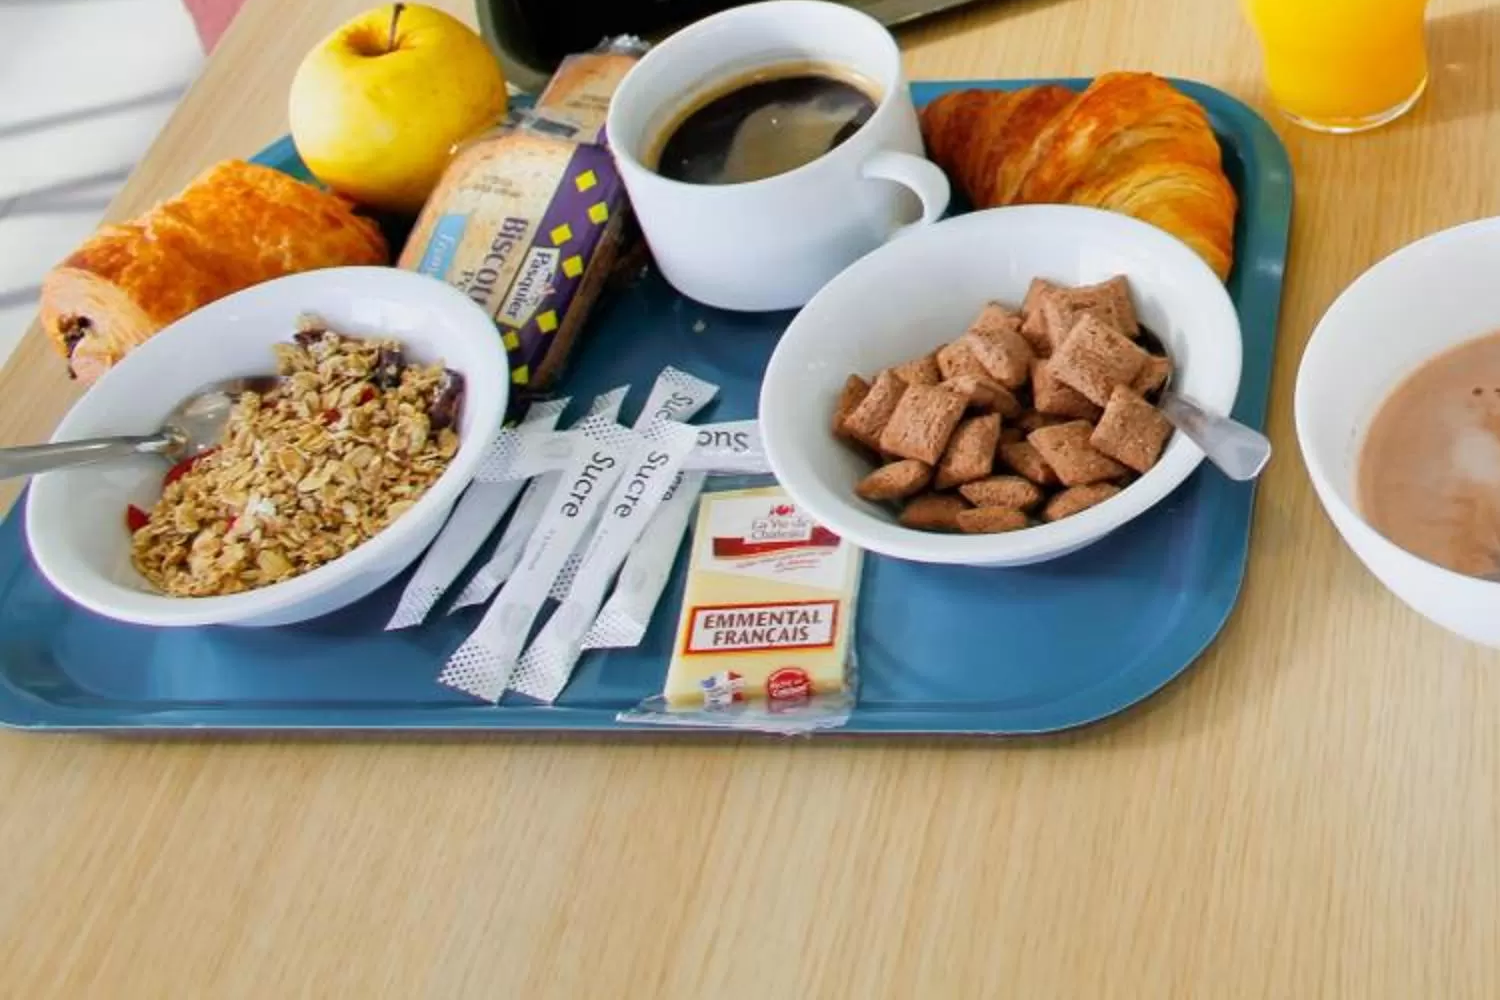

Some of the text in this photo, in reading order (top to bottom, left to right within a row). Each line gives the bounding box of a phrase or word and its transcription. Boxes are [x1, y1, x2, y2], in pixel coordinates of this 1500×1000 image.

[505, 251, 552, 319] Pasquier
[655, 391, 694, 422] Suc
[696, 429, 751, 452] Suc
[561, 450, 616, 518] Sucre
[613, 450, 670, 518] Sucre
[703, 609, 823, 629] EMMENTAL
